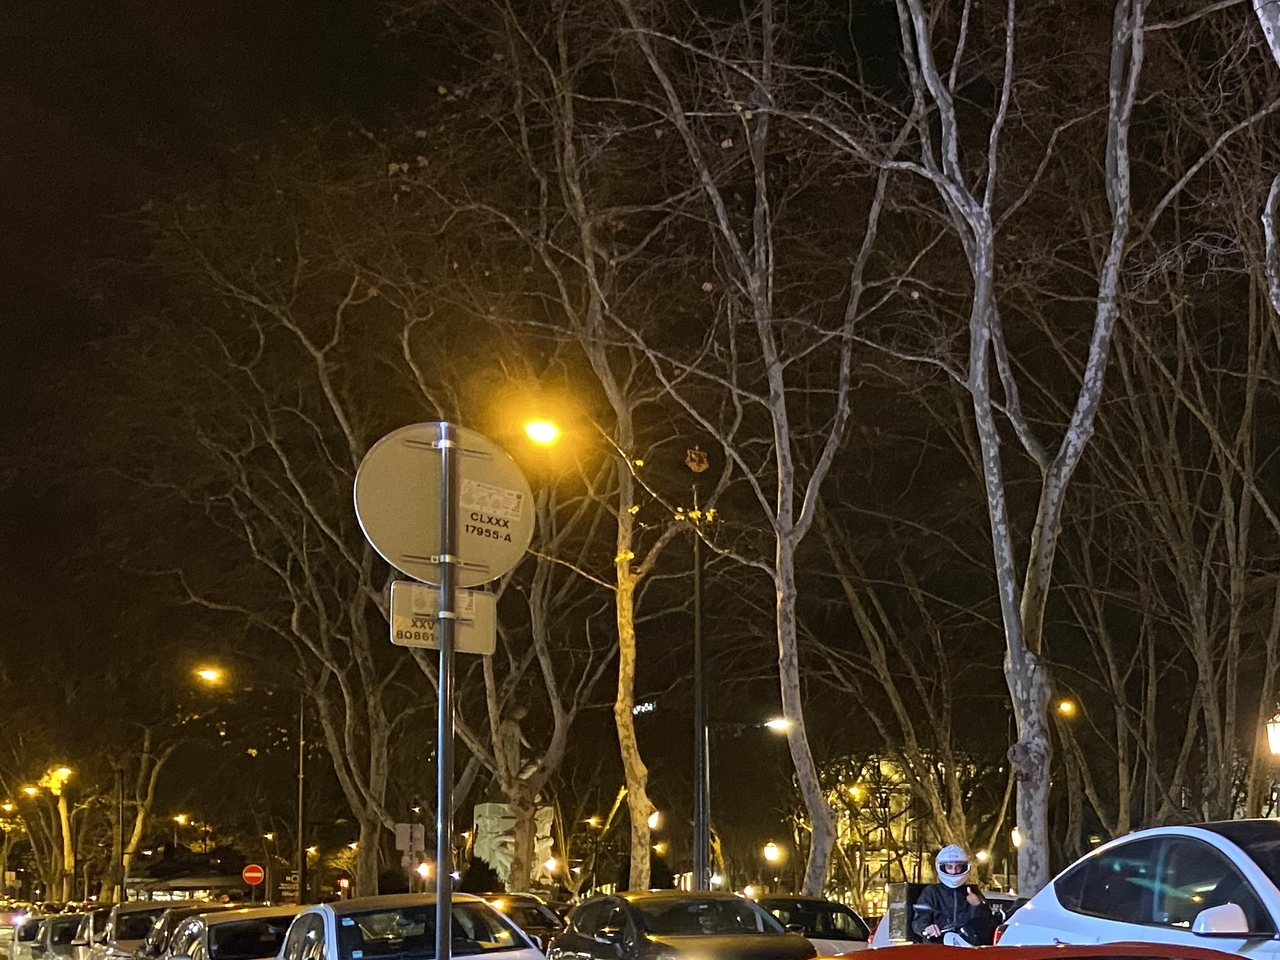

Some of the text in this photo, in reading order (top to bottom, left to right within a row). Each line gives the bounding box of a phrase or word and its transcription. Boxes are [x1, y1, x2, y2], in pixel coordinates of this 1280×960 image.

[470, 512, 510, 529] CLXXX
[465, 524, 512, 543] 17955-A
[396, 630, 440, 642] 80861-
